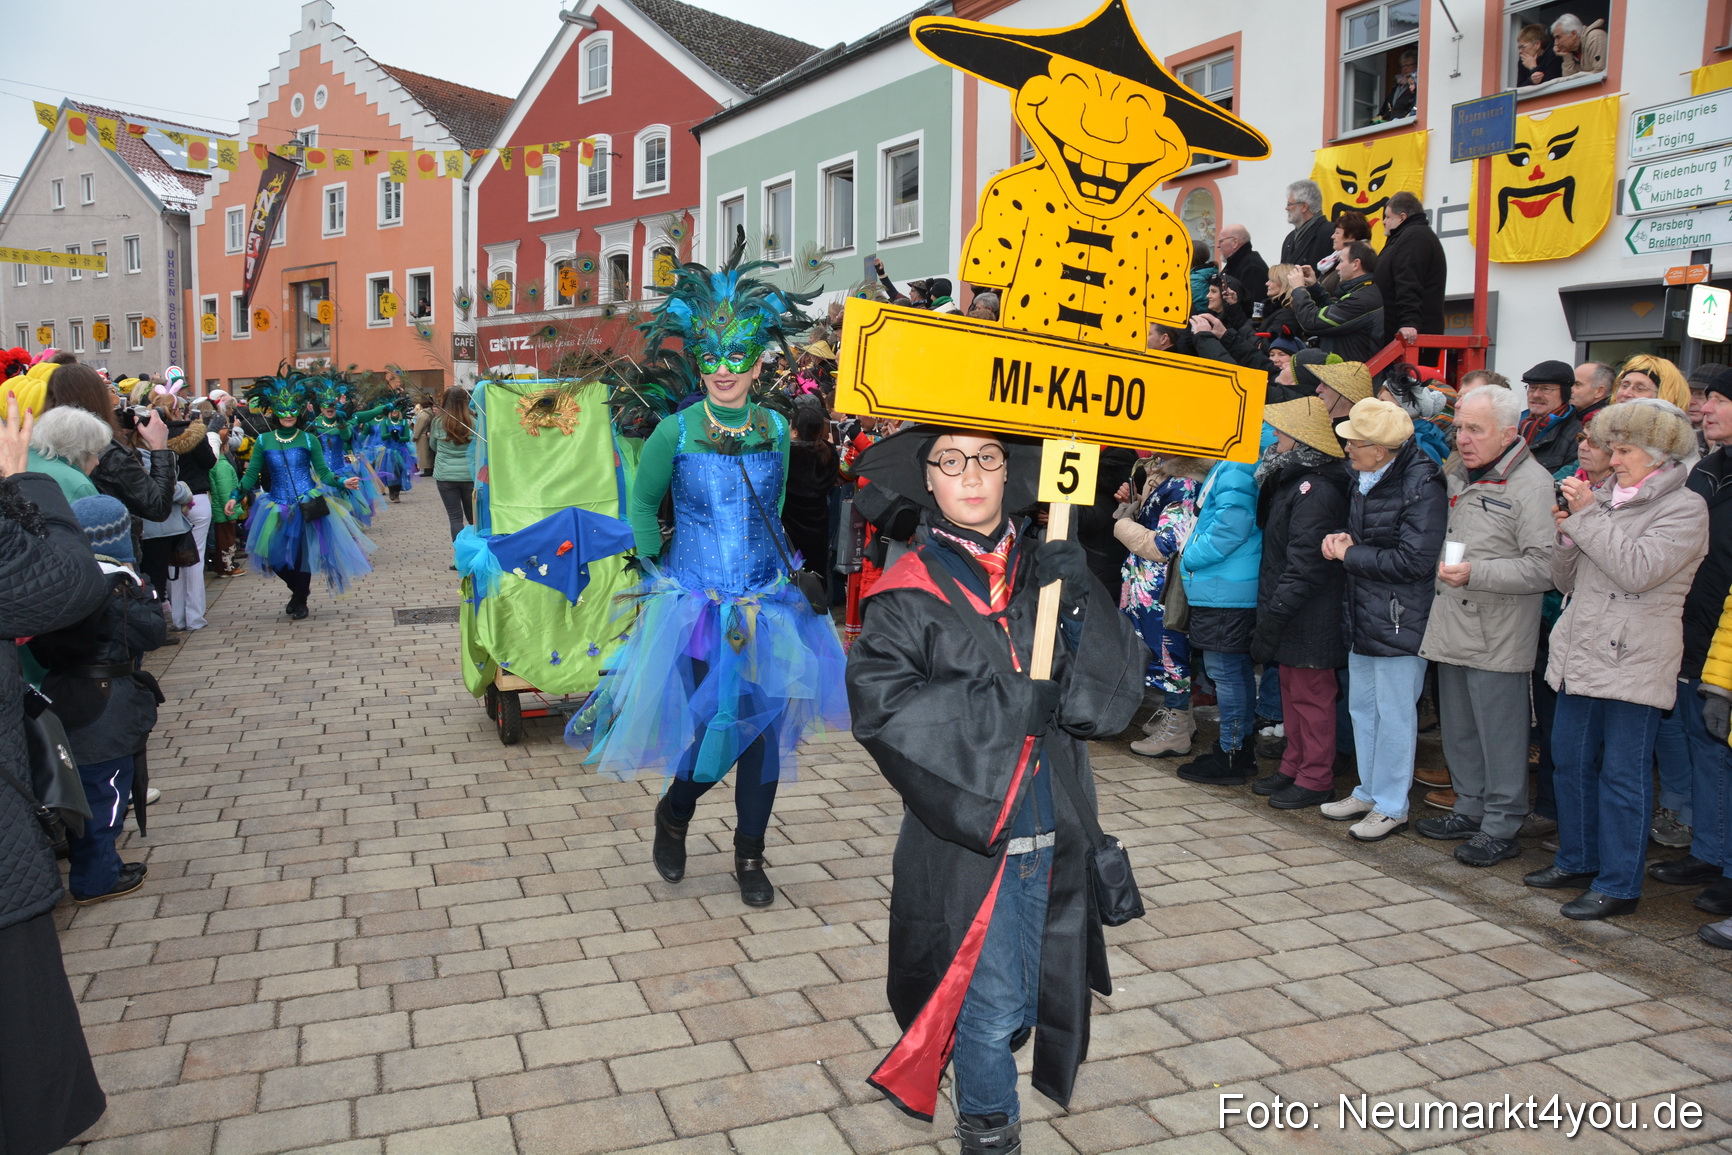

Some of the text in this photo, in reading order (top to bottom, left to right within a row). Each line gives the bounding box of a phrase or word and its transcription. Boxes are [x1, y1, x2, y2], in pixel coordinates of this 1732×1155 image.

[1658, 103, 1718, 125] Beilngries
[1657, 132, 1695, 147] Töging
[1652, 160, 1717, 181] Riedenburg
[1650, 185, 1703, 203] Mühlbach
[1650, 218, 1693, 232] Parsberg
[1648, 233, 1711, 249] Breitenbrunn
[167, 250, 176, 296] UHREN
[455, 336, 474, 347] CAFÉ
[989, 357, 1145, 421] MI-KA-DO
[1056, 452, 1080, 495] 5
